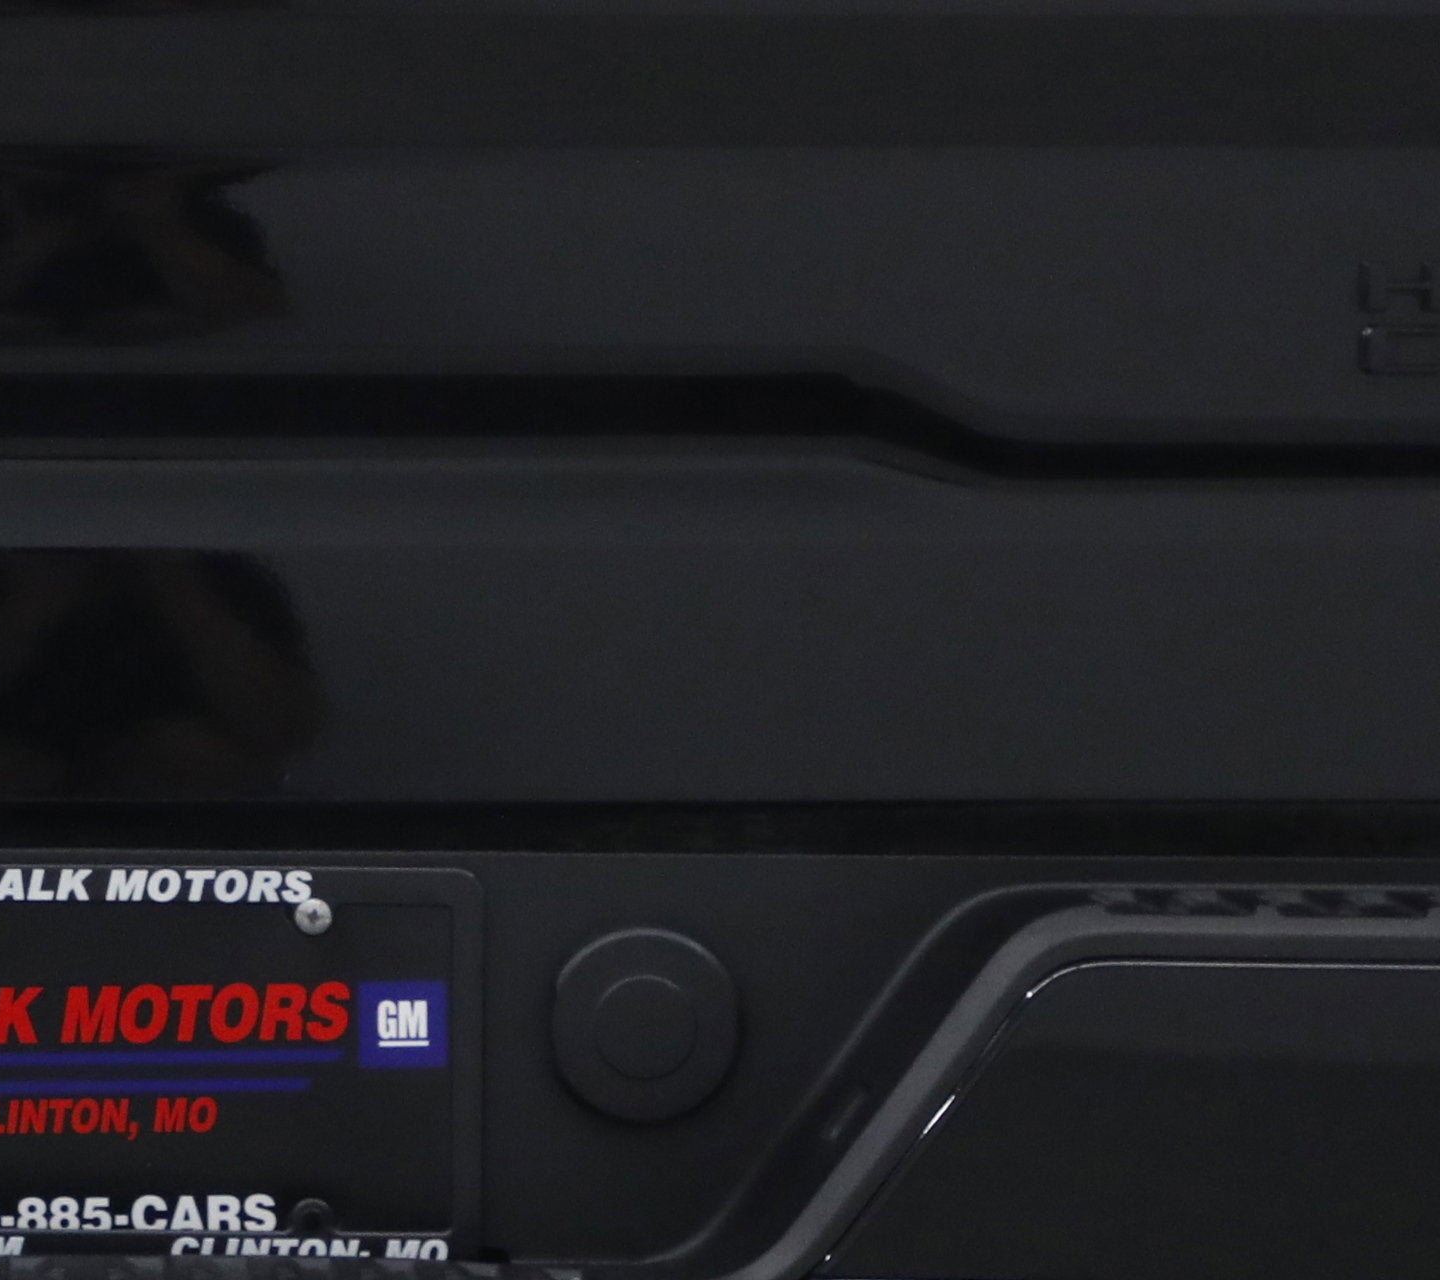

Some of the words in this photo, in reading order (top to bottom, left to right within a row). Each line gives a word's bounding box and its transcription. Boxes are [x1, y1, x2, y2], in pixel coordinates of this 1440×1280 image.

[105, 867, 314, 903] MOTORS
[61, 981, 351, 1044] MOTORS
[376, 999, 429, 1040] GM
[154, 1097, 218, 1132] MO
